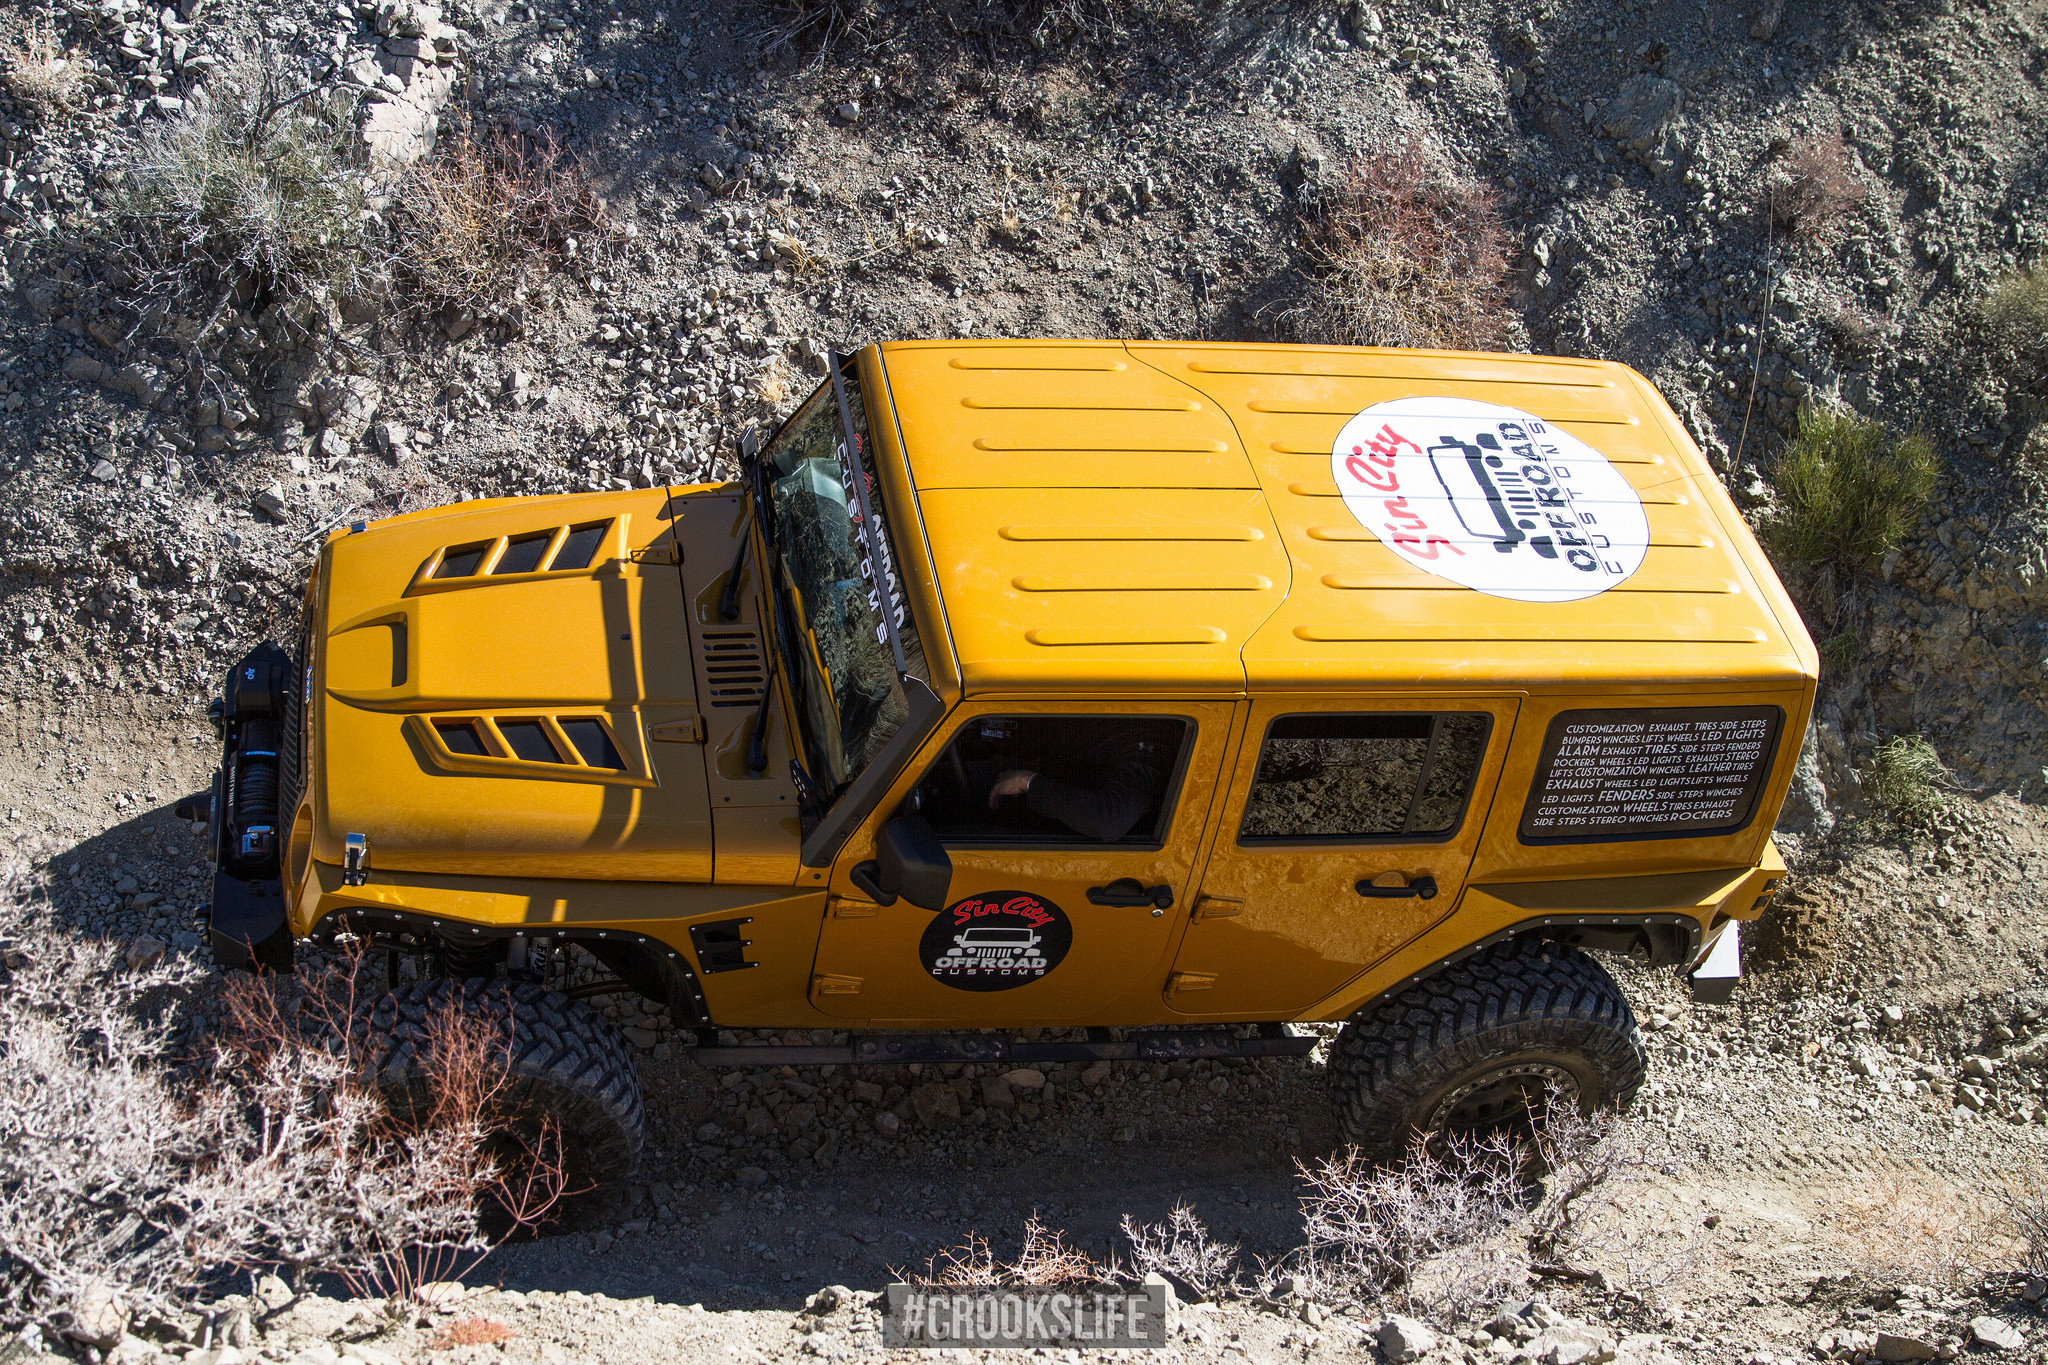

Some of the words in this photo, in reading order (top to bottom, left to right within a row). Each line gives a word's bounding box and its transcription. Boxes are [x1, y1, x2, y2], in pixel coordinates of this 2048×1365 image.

[1345, 423, 1423, 492] City
[1496, 421, 1599, 573] OFFROAD
[1529, 422, 1624, 574] CUSTOMS
[1383, 494, 1466, 561] Sin
[836, 442, 888, 645] CUSTOMS
[1566, 724, 1645, 734] CUSTOMIZATION
[1649, 722, 1691, 732] EXHAUST
[1694, 721, 1718, 731] TIRES
[1719, 720, 1739, 730] SIDE
[1740, 719, 1767, 729] STEPS
[1562, 736, 1601, 745] BUMPERS
[1603, 735, 1640, 744] WINCHES
[1641, 734, 1665, 743] LIFTS
[1667, 733, 1700, 742] WHEELS
[1701, 731, 1722, 741] LED
[1725, 729, 1766, 740] LIGHTS
[1557, 745, 1600, 757] ALARM
[1601, 746, 1643, 756] EXHAUST
[1644, 744, 1678, 755] TIRES
[1679, 744, 1699, 753] SIDE
[1700, 743, 1726, 752] STEPS
[1726, 741, 1762, 751] FENDERS
[1553, 758, 1595, 767] ROCKERS
[1599, 757, 1632, 766] WHEELS
[1633, 756, 1650, 765] LED
[1652, 755, 1682, 764] LIGHTS
[1685, 753, 1726, 763] EXHAUST
[1726, 750, 1760, 761] STEREO
[1550, 768, 1574, 778] LIFTS
[1574, 766, 1648, 777] CUSTOMIZATION
[1649, 765, 1686, 774] WINCHES
[1688, 762, 1731, 773] LEATHER
[1732, 761, 1754, 771] TIRES
[1545, 778, 1604, 790] EXHAUST
[1604, 779, 1639, 788] WHEELS
[1640, 778, 1657, 787] LED
[1659, 777, 1691, 786] LIGHTS
[1691, 776, 1714, 785] LIFTS
[1715, 774, 1749, 783] WHEELS
[1541, 795, 1559, 804] LED
[1561, 794, 1594, 803] LIGHTS
[1597, 788, 1656, 802] FENDERS
[1655, 791, 1676, 800] SIDE
[1677, 790, 1704, 799] STEPS
[1706, 787, 1744, 797] WINCHES
[1537, 805, 1620, 816] CUSTOMIZATION
[1623, 801, 1669, 813] WHEELS
[1668, 801, 1693, 811] TIRES
[1692, 799, 1736, 810] EXHAUST
[1533, 818, 1555, 827] SIDE
[1557, 817, 1587, 826] STEPS
[1588, 815, 1627, 825] STEREO
[1628, 814, 1670, 824] WINCHES
[1669, 809, 1733, 821] ROCKERS
[953, 899, 999, 926] Sin
[1002, 896, 1055, 928] City
[935, 957, 1047, 968] OFFROAD
[932, 968, 1045, 976] CUSTOMS
